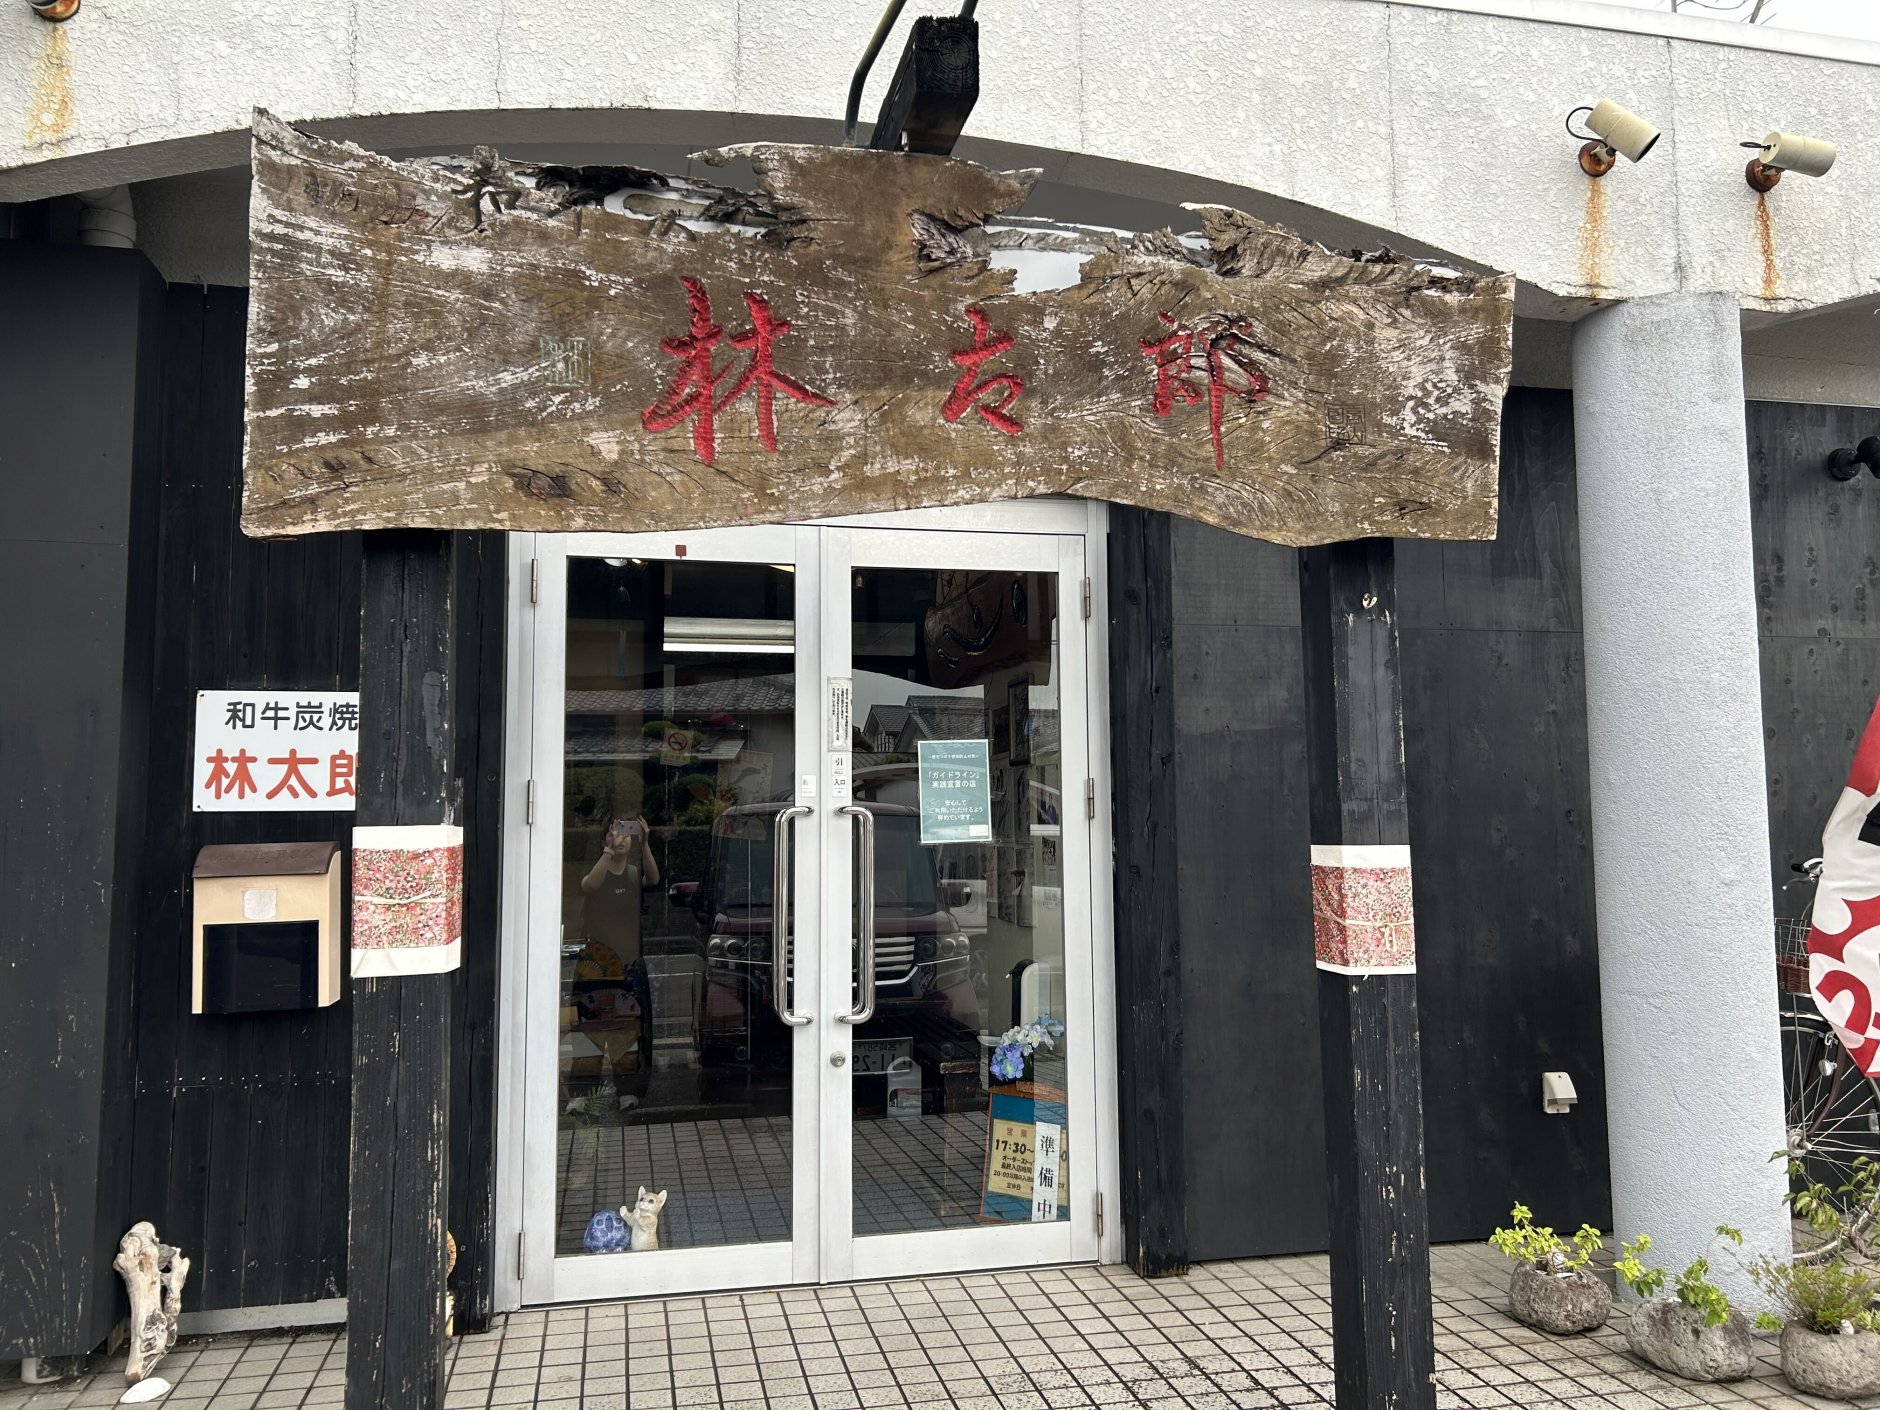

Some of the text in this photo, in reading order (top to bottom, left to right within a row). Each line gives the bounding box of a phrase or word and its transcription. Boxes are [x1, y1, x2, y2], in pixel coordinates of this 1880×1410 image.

[224, 701, 359, 732] 和牛炭焼
[835, 757, 843, 766] 引
[833, 778, 846, 786] 入口
[1036, 1135, 1055, 1220] 準備中
